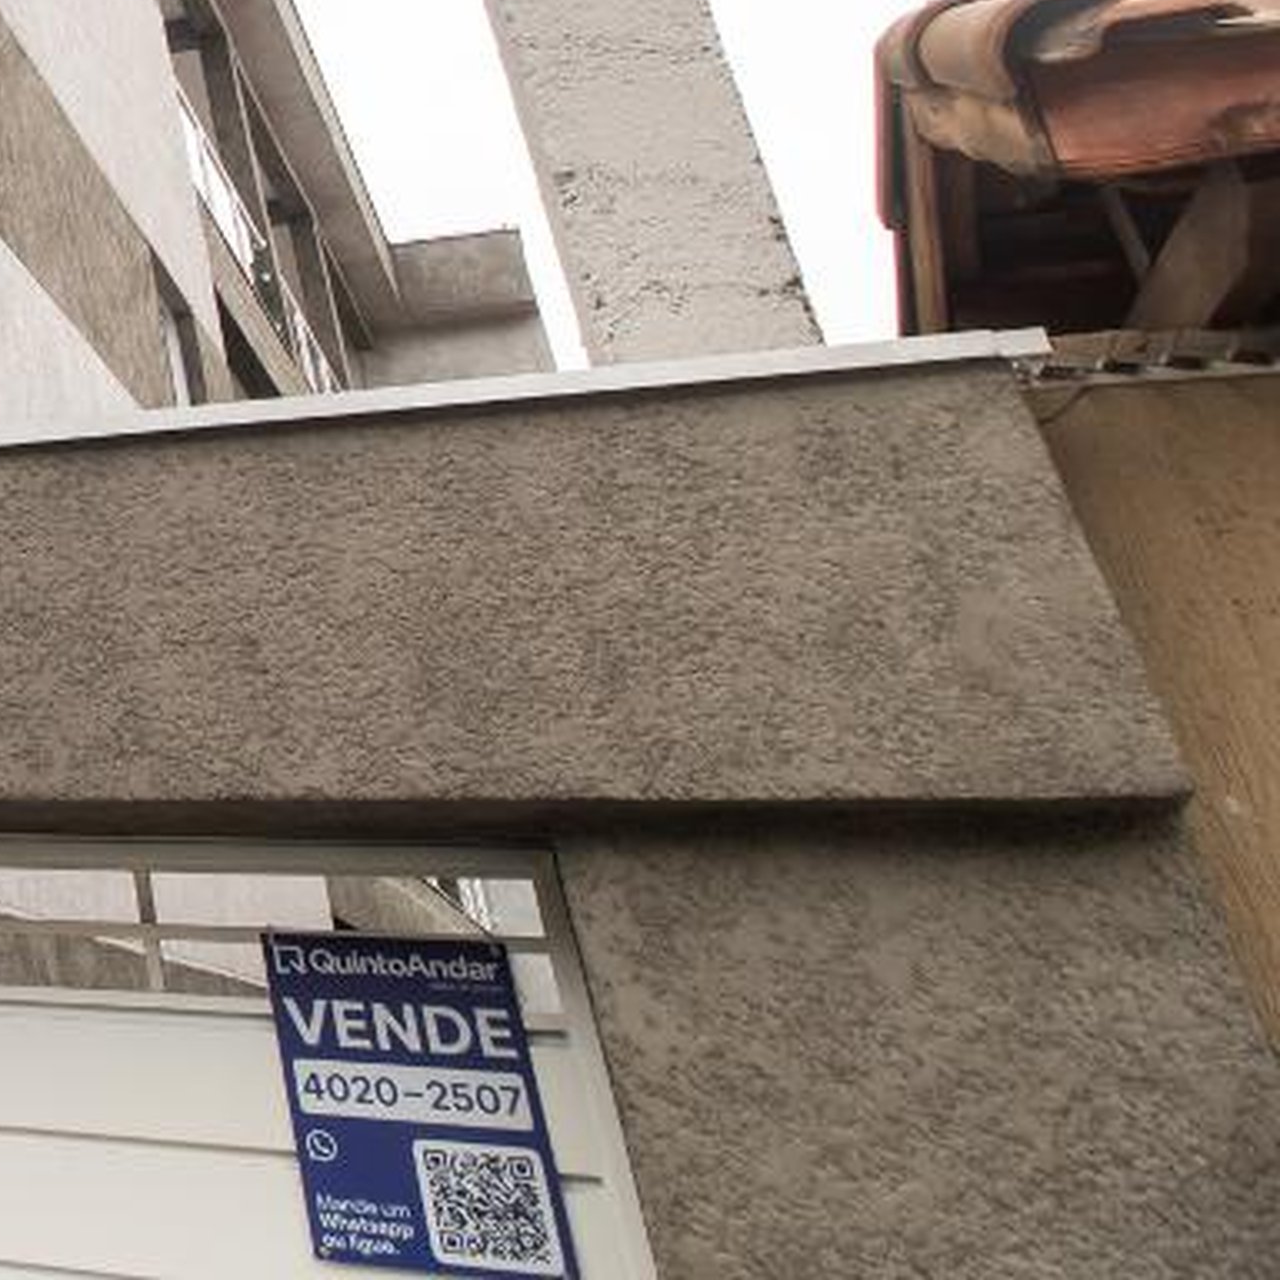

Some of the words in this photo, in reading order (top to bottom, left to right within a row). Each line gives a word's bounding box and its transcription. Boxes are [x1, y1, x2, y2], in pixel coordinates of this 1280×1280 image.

[308, 948, 497, 983] QuintoAndar
[282, 996, 519, 1059] VENDE
[303, 1071, 520, 1117] 4020-2507
